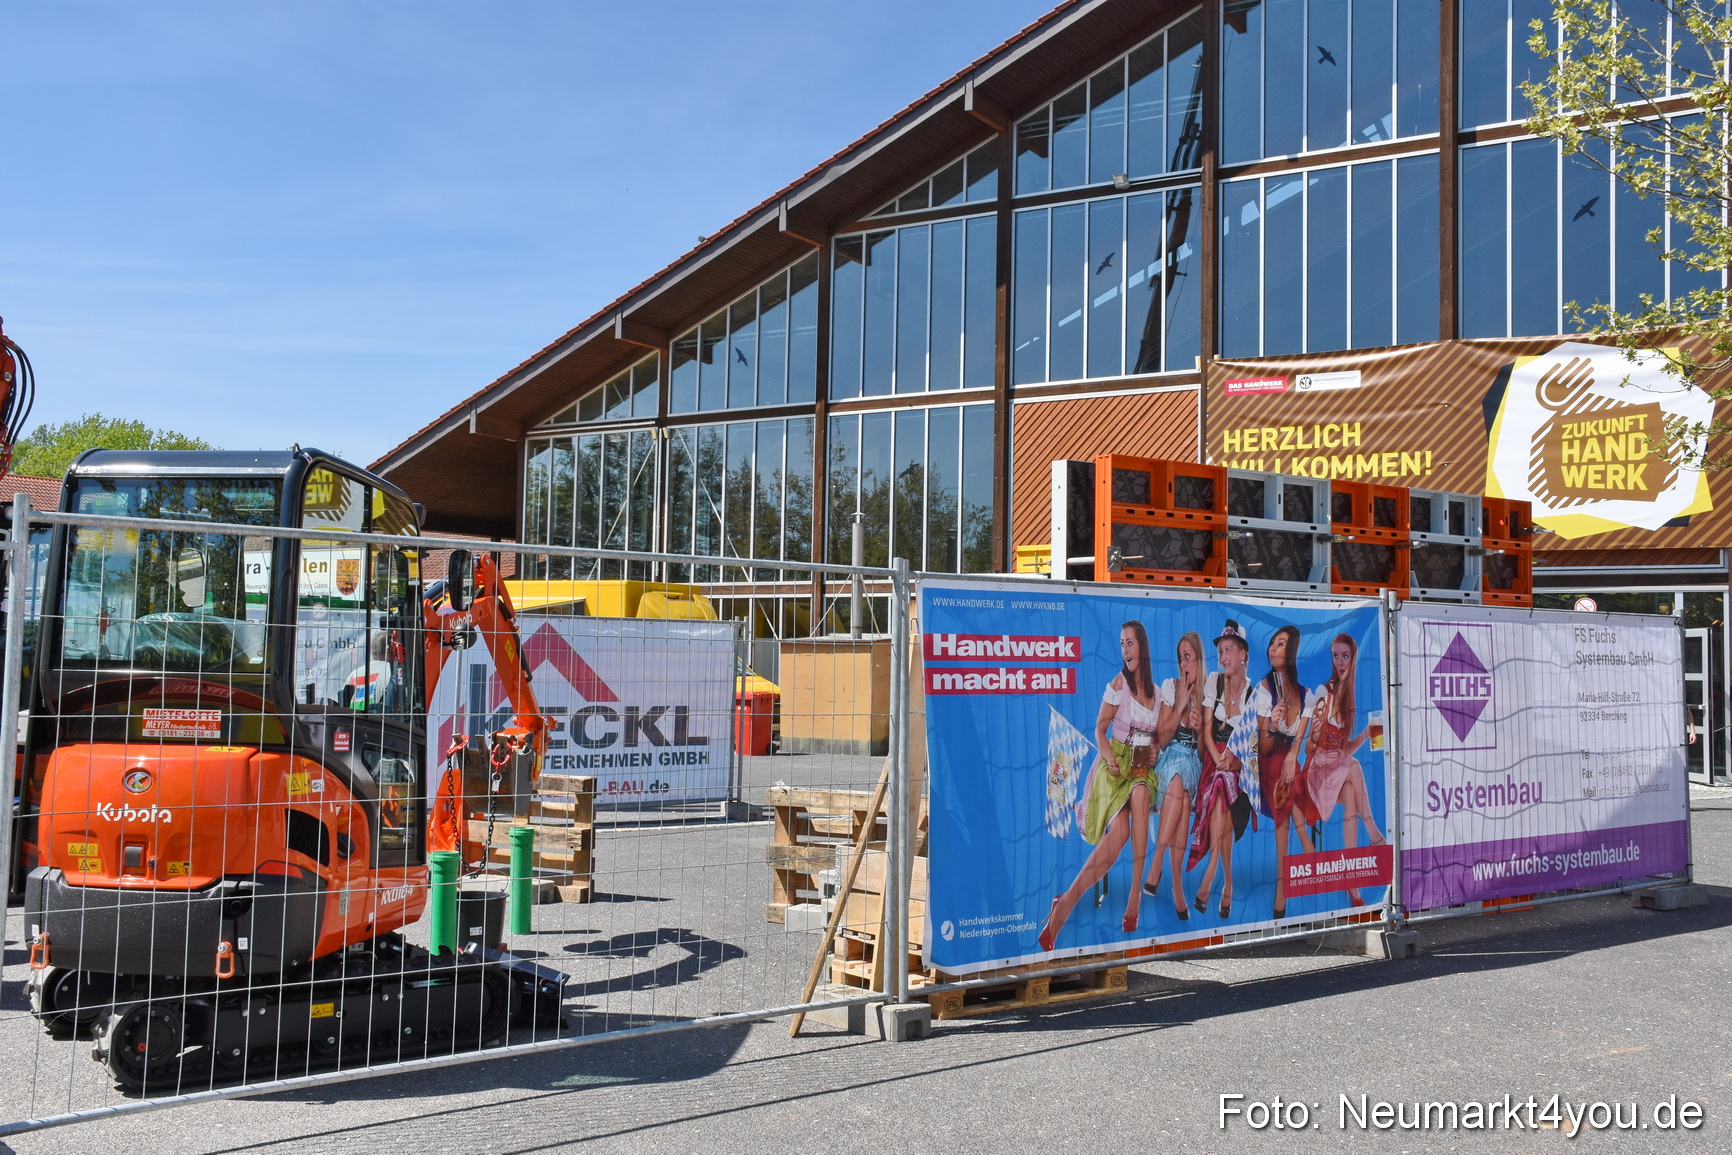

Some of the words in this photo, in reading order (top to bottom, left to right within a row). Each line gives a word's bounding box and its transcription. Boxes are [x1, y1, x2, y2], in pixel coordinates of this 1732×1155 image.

[1244, 379, 1283, 388] HANDWERK
[1561, 413, 1649, 440] ZUKUNFT
[1223, 422, 1361, 453] HERZLICH
[1561, 431, 1649, 464] HAND
[1560, 463, 1649, 491] WERK
[932, 597, 1004, 609] WWW.HANDWERK.DE
[1010, 600, 1066, 611] WWW.HWKNO.DE
[1574, 627, 1587, 643] FS
[1588, 628, 1616, 644] Fuchs
[932, 633, 1076, 658] Handwerk
[1576, 650, 1626, 670] Systembau
[1628, 651, 1654, 666] GmbH
[932, 667, 1027, 691] macht
[1031, 668, 1068, 690] an!
[1429, 676, 1492, 698] FUCHS
[1578, 691, 1631, 703] Maria-Hilf-Straße
[1632, 691, 1640, 702] 72
[145, 709, 219, 721] MIETFLOTTE
[145, 720, 171, 729] MEYER
[1580, 710, 1600, 722] 92334
[1601, 709, 1628, 723] Berching
[658, 750, 709, 766] GMBH
[1582, 768, 1593, 779] Fax
[1427, 774, 1542, 820] Systembau
[1583, 786, 1597, 798] Mail
[96, 802, 172, 823] Kubota
[1289, 863, 1312, 878] DAS
[1316, 854, 1378, 875] HANDWERK
[1472, 840, 1640, 882] www.fuchs-systembau.de
[958, 912, 1024, 927] Handwerkskammer
[959, 921, 1037, 939] Niederbayern-Oberpfalz
